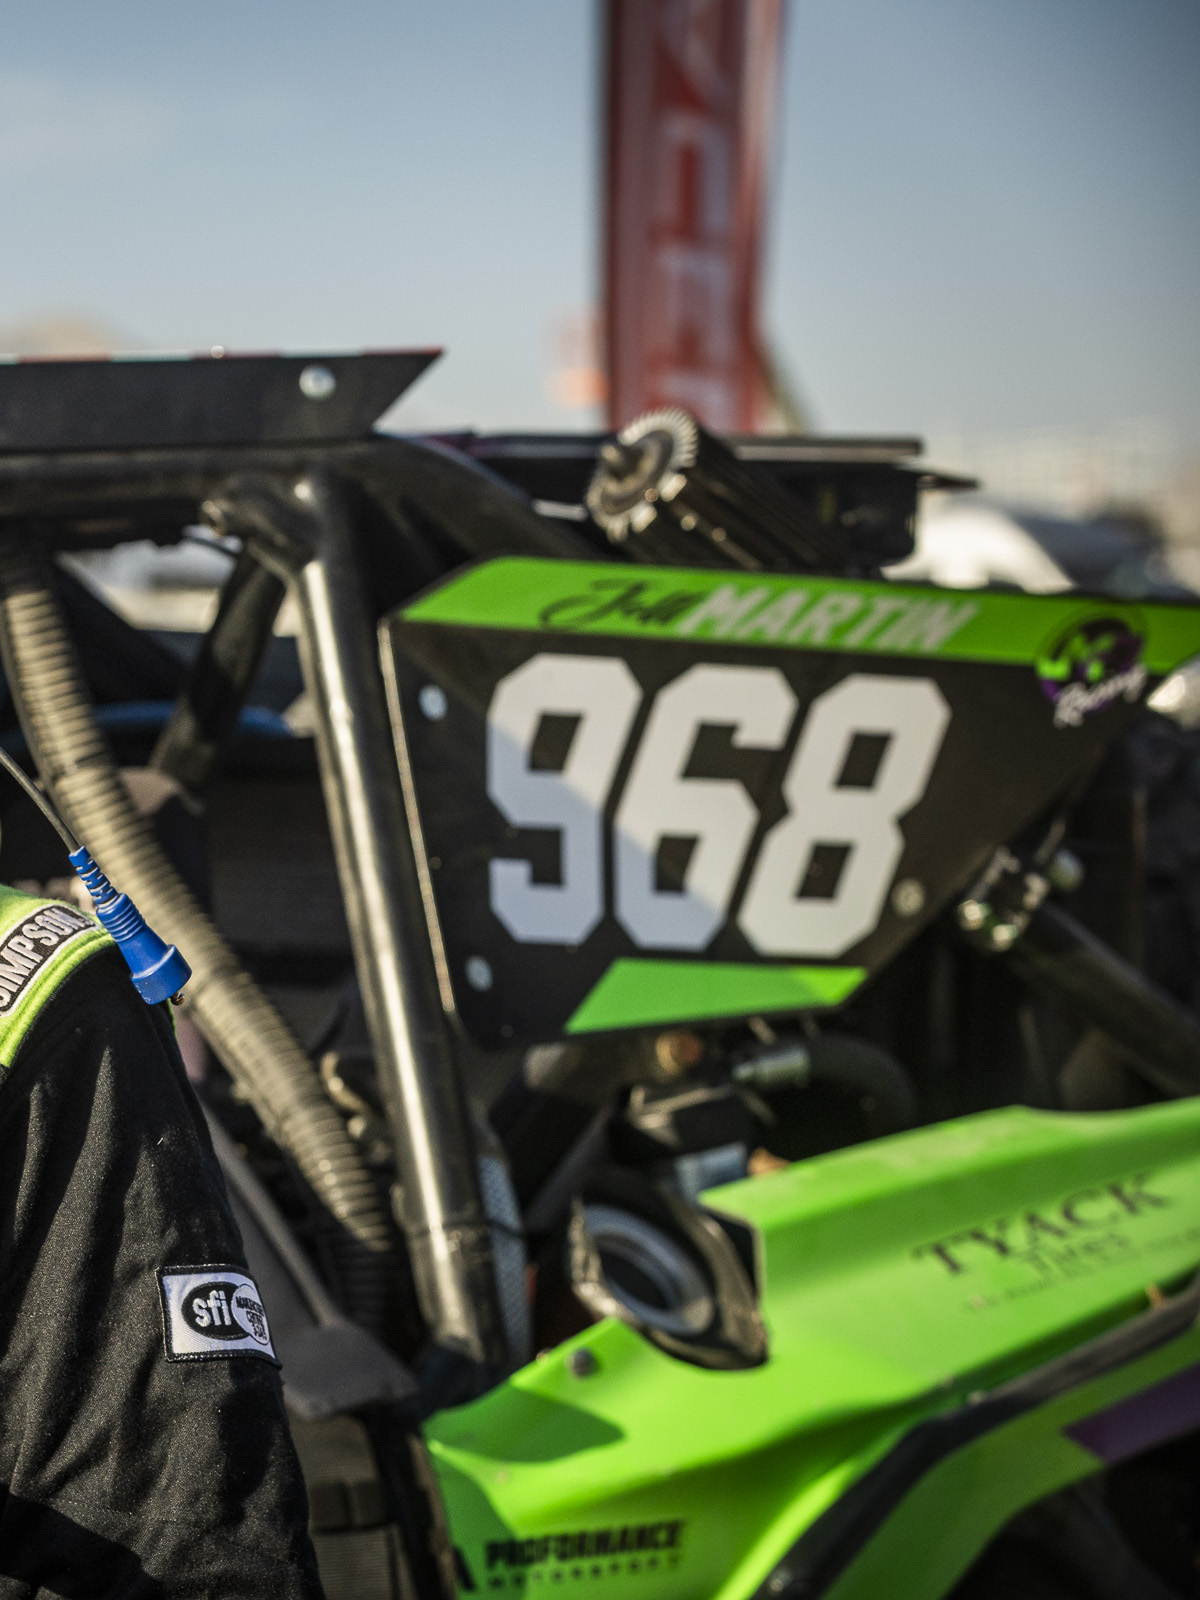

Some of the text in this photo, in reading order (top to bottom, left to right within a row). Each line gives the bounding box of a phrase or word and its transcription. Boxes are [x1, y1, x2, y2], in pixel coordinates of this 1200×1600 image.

[673, 582, 982, 656] MARTIN
[486, 651, 953, 960] 968
[907, 1172, 1166, 1276] TYACK
[192, 1290, 232, 1327] sfi
